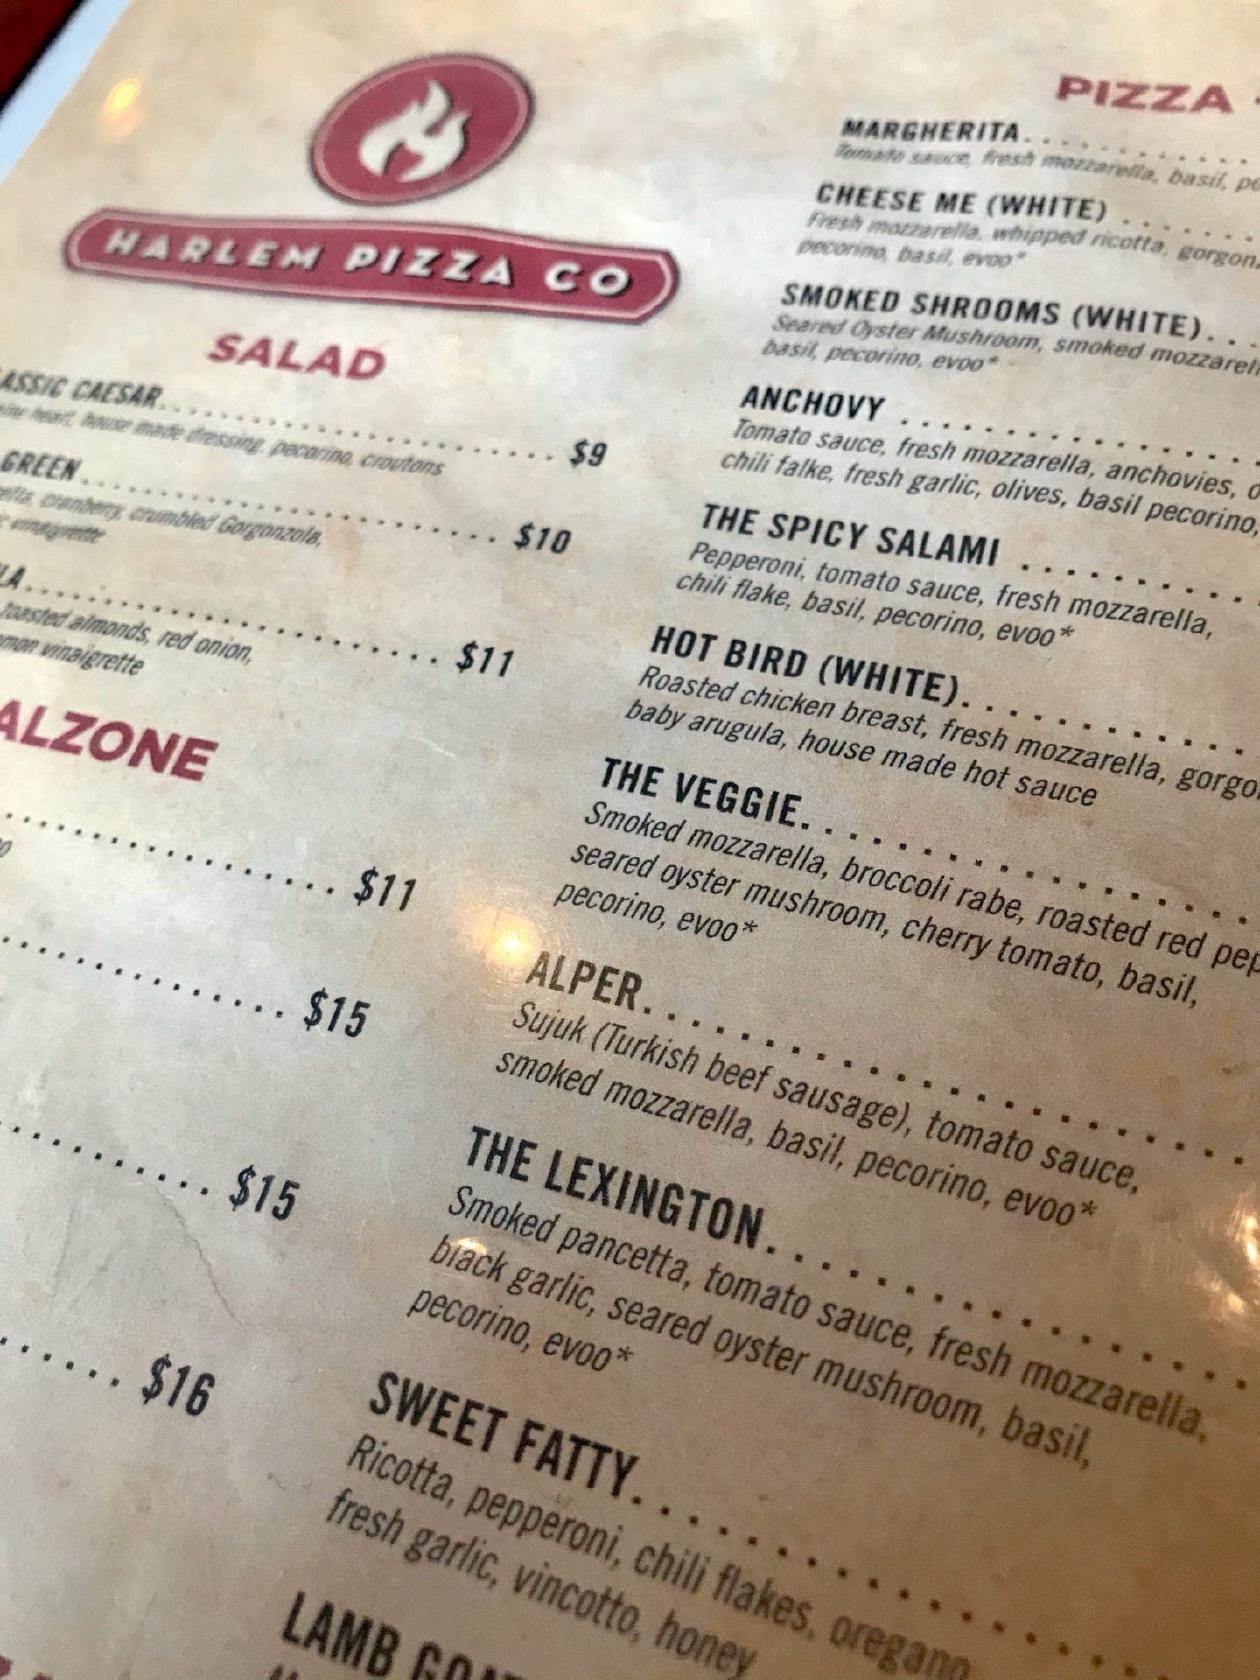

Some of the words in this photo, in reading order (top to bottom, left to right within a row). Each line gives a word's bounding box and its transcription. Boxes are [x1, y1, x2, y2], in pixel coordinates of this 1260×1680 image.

[1055, 75, 1234, 114] PIZZA
[840, 118, 1019, 143] MARGHERITA
[835, 143, 905, 163] Tomato
[908, 152, 972, 168] sauce,
[982, 150, 1035, 166] fresh
[1042, 156, 1158, 182] mozzarella,
[1168, 169, 1227, 190] basil,
[807, 211, 863, 229] Fresh
[992, 226, 1088, 246] whipped
[816, 182, 926, 212] CHEESE
[935, 191, 977, 214] ME
[986, 194, 1107, 223] (WHITE)
[105, 228, 324, 271] HARLEM
[345, 244, 515, 287] PIZZA
[544, 260, 632, 297] CO
[796, 239, 887, 262] pecorino,
[772, 314, 847, 334] Seared
[851, 320, 918, 340] Oyster
[922, 325, 1042, 353] Mushroom,
[1053, 339, 1145, 360] smoked
[781, 282, 900, 312] SMOKED
[910, 291, 1061, 325] SHROOMS
[1072, 304, 1201, 341] (WHITE)
[207, 333, 386, 381] SALAD
[762, 339, 819, 360] basil,
[824, 347, 922, 368] pecorino,
[72, 380, 164, 408] CAESAR
[569, 438, 608, 469] $9
[739, 384, 886, 422] ANCHOVY
[360, 454, 445, 476] croutons
[733, 417, 812, 445] Tomato
[815, 432, 885, 457] sauce,
[896, 437, 956, 460] fresh
[962, 447, 1095, 479] mozzarella,
[1105, 464, 1235, 499] anchovies,
[0, 449, 82, 480] GREEN
[513, 521, 572, 555] $10
[720, 451, 770, 473] chili
[774, 456, 833, 483] falke,
[844, 463, 904, 488] fresh
[906, 473, 980, 499] garlic,
[991, 479, 1067, 508] olives,
[1077, 486, 1143, 515] basil
[1144, 503, 1258, 538] pecorino,
[129, 507, 220, 530] crumbled
[217, 515, 322, 547] Gorgonzola,
[702, 502, 760, 536] THE
[767, 512, 869, 550] SPICY
[876, 526, 1000, 567] SALAMI
[676, 572, 727, 596] chili
[731, 579, 791, 611] flake,
[801, 590, 866, 622] basil,
[872, 607, 984, 641] pecorino,
[689, 541, 805, 581] Pepperoni,
[816, 562, 900, 592] tomato
[906, 579, 983, 607] sauce,
[997, 584, 1061, 612] fresh
[1068, 598, 1212, 640] mozzarella,
[40, 643, 144, 676] vinaigrette
[67, 614, 151, 645] almonds,
[157, 631, 198, 650] red
[194, 638, 252, 666] onion,
[455, 640, 514, 677] $11
[650, 625, 718, 662] HOT
[723, 638, 808, 678] BIRD
[818, 654, 958, 707] (WHITE)
[625, 698, 687, 731] baby
[688, 715, 787, 750] arugula,
[798, 728, 875, 762] house
[880, 749, 956, 779] made
[963, 759, 1010, 789] hot
[1014, 775, 1098, 806] sauce
[638, 665, 739, 702] Roasted
[739, 686, 836, 718] chicken
[840, 700, 927, 739] breast,
[939, 718, 1008, 751] fresh
[1014, 738, 1165, 785] mozzarella,
[601, 756, 664, 797] THE
[675, 771, 802, 828] VEGGIE
[353, 866, 416, 912] $11
[552, 883, 666, 930] pecorino,
[584, 801, 687, 843] Smoked
[686, 829, 827, 880] mozzarella,
[839, 856, 954, 902] broccoli
[955, 887, 1024, 925] rabe,
[1036, 906, 1152, 947] roasted
[1156, 931, 1208, 959] red
[570, 844, 660, 878] seared
[660, 864, 741, 896] oyster
[743, 883, 889, 939] mushroom,
[901, 916, 993, 961] cherry
[997, 936, 1103, 990] tomato,
[1117, 962, 1197, 1009] basil,
[303, 987, 371, 1038] $15
[525, 951, 643, 1011] ALPER
[512, 1001, 588, 1043] Sujuk
[591, 1022, 699, 1075] (Turkish
[705, 1052, 774, 1093] beef
[773, 1077, 911, 1138] sausage),
[926, 1110, 1034, 1162] tomato
[1040, 1145, 1138, 1194] sauce,
[495, 1053, 604, 1096] smoked
[603, 1081, 753, 1146] mozzarella,
[766, 1119, 846, 1171] basil,
[853, 1151, 990, 1209] pecorino,
[228, 1164, 300, 1221] $15
[466, 1125, 538, 1182] THE
[544, 1149, 765, 1249] LEXINGTON
[406, 1289, 530, 1353] pecorino,
[448, 1186, 561, 1243] Smoked
[556, 1227, 690, 1291] pancetta,
[704, 1262, 811, 1319] tomato
[816, 1302, 914, 1356] sauce,
[928, 1326, 1012, 1377] fresh
[1021, 1361, 1205, 1442] mozzarella,
[429, 1234, 508, 1283] black
[507, 1267, 594, 1317] garlic,
[607, 1297, 712, 1346] seared
[713, 1329, 810, 1375] oyster
[813, 1359, 984, 1437] mushroom,
[1002, 1405, 1089, 1469] basil,
[141, 1353, 215, 1417] $16
[368, 1371, 508, 1453] SWEET
[513, 1418, 640, 1499] FATTY
[326, 1488, 404, 1544] fresh
[403, 1528, 498, 1588] garlic,
[514, 1565, 640, 1642] vincotto,
[655, 1610, 756, 1678] honey
[346, 1433, 454, 1508] Ricotta,
[464, 1486, 619, 1569] pepperoni,
[634, 1543, 710, 1593] chili
[713, 1564, 813, 1637] flakes,
[830, 1615, 970, 1680] oregano
[281, 1591, 401, 1678] LAMB
